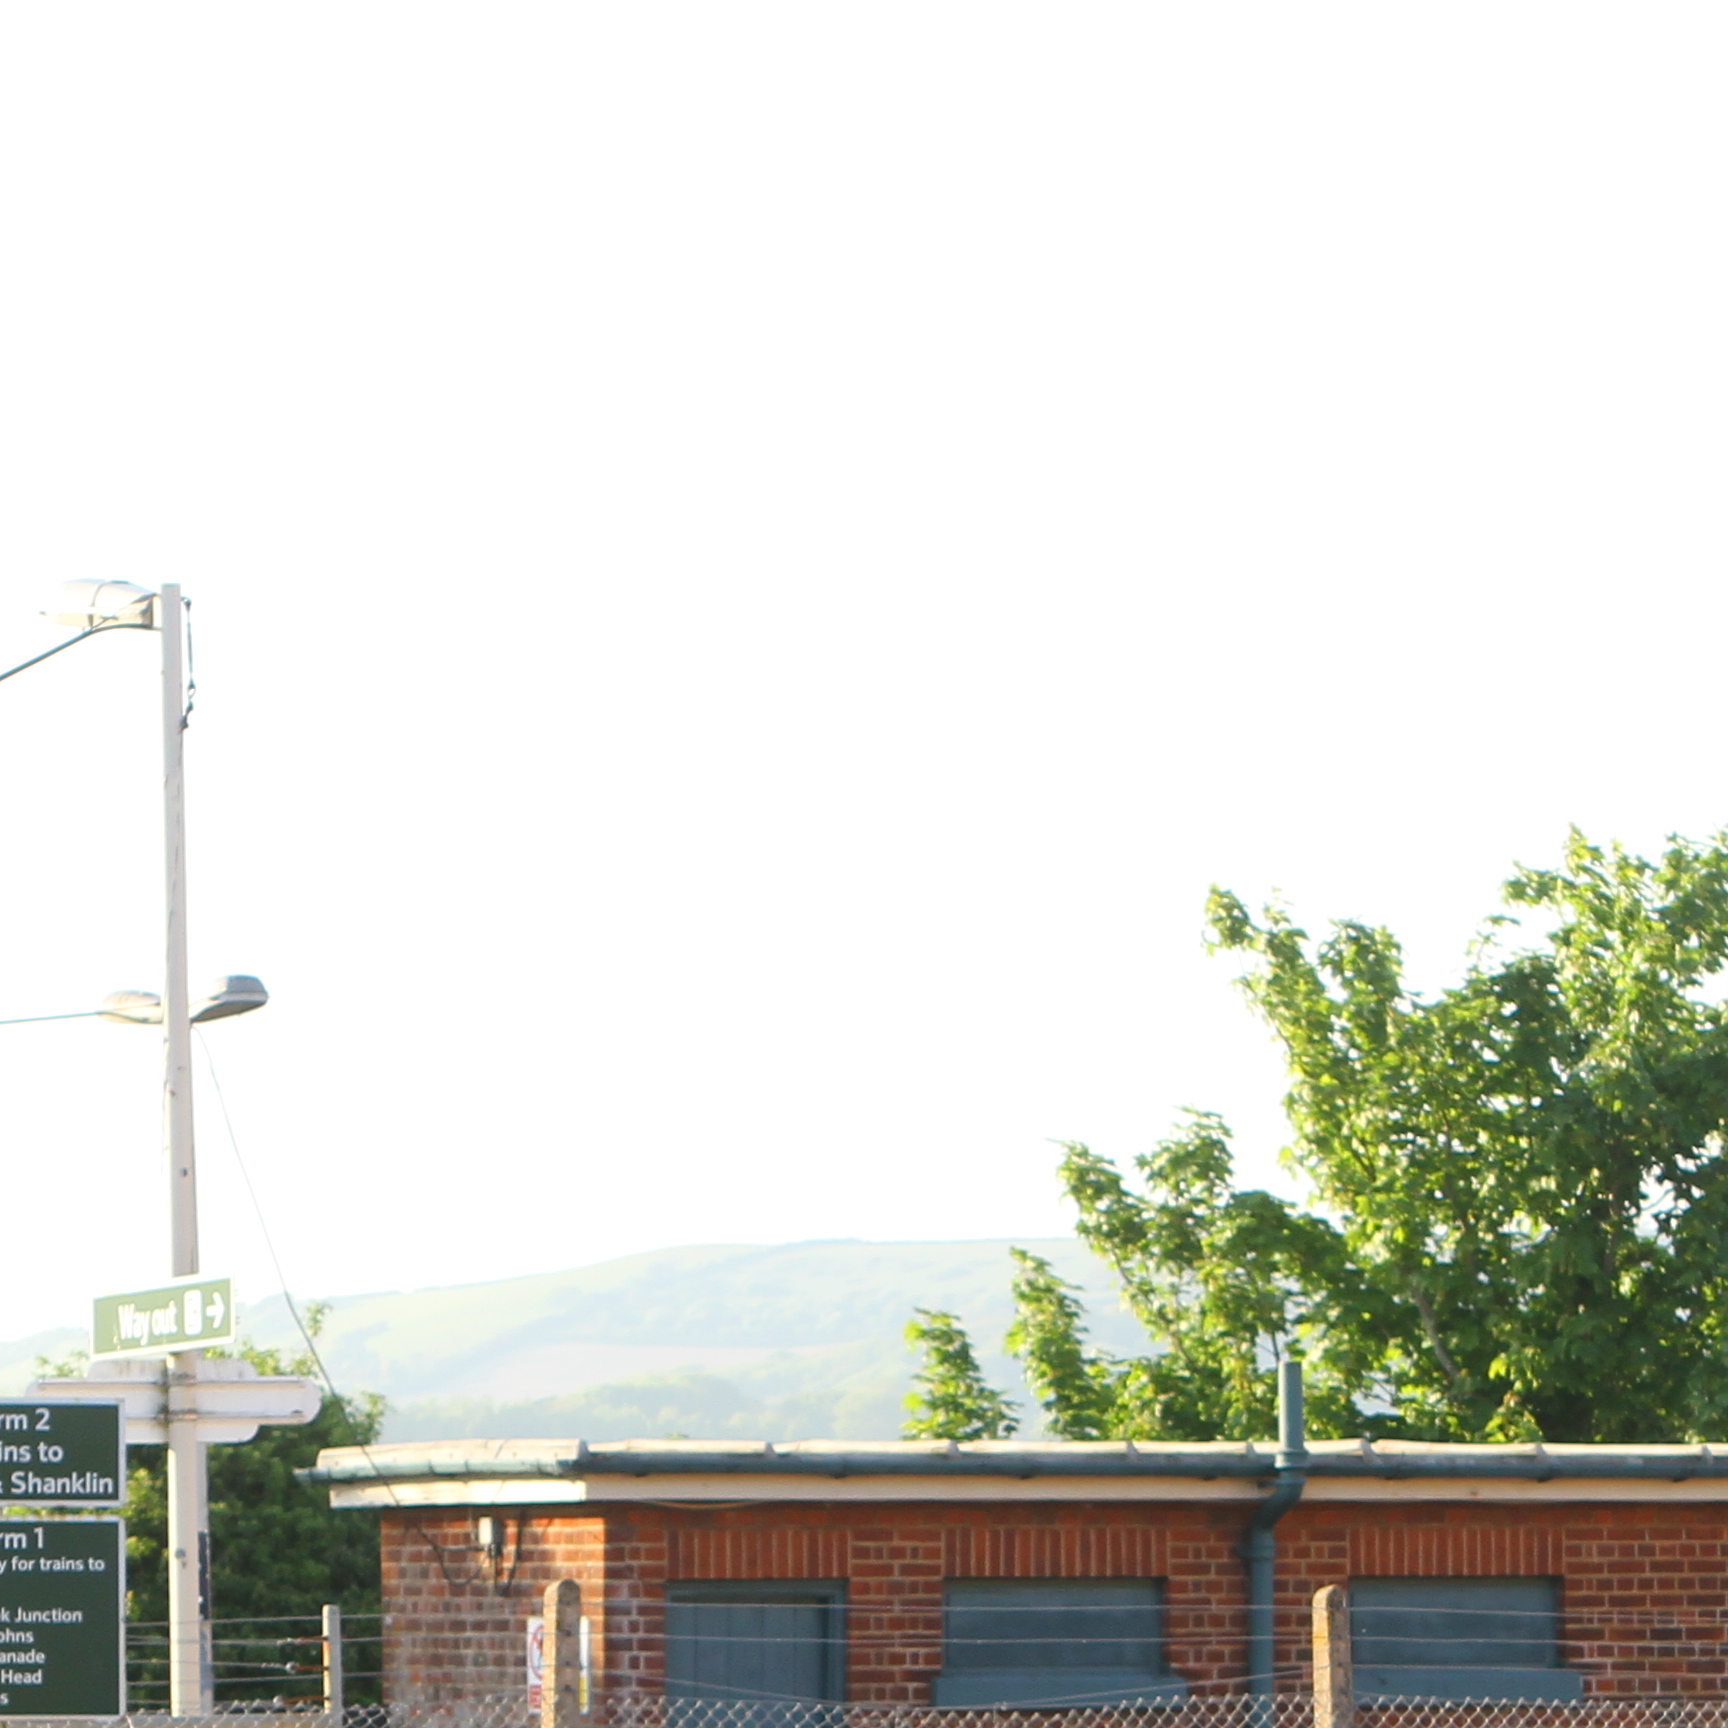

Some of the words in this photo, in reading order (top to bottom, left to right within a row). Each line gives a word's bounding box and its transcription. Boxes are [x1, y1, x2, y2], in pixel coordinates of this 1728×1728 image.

[118, 1303, 150, 1345] Way
[152, 1300, 178, 1336] out
[34, 1408, 51, 1431] 2
[37, 1442, 65, 1463] to
[10, 1471, 114, 1494] Shanklin
[33, 1527, 45, 1549] 1
[11, 1556, 35, 1571] for
[39, 1557, 84, 1571] trains
[88, 1558, 105, 1571] to
[14, 1607, 83, 1623] Junction
[0, 1669, 43, 1685] Head
